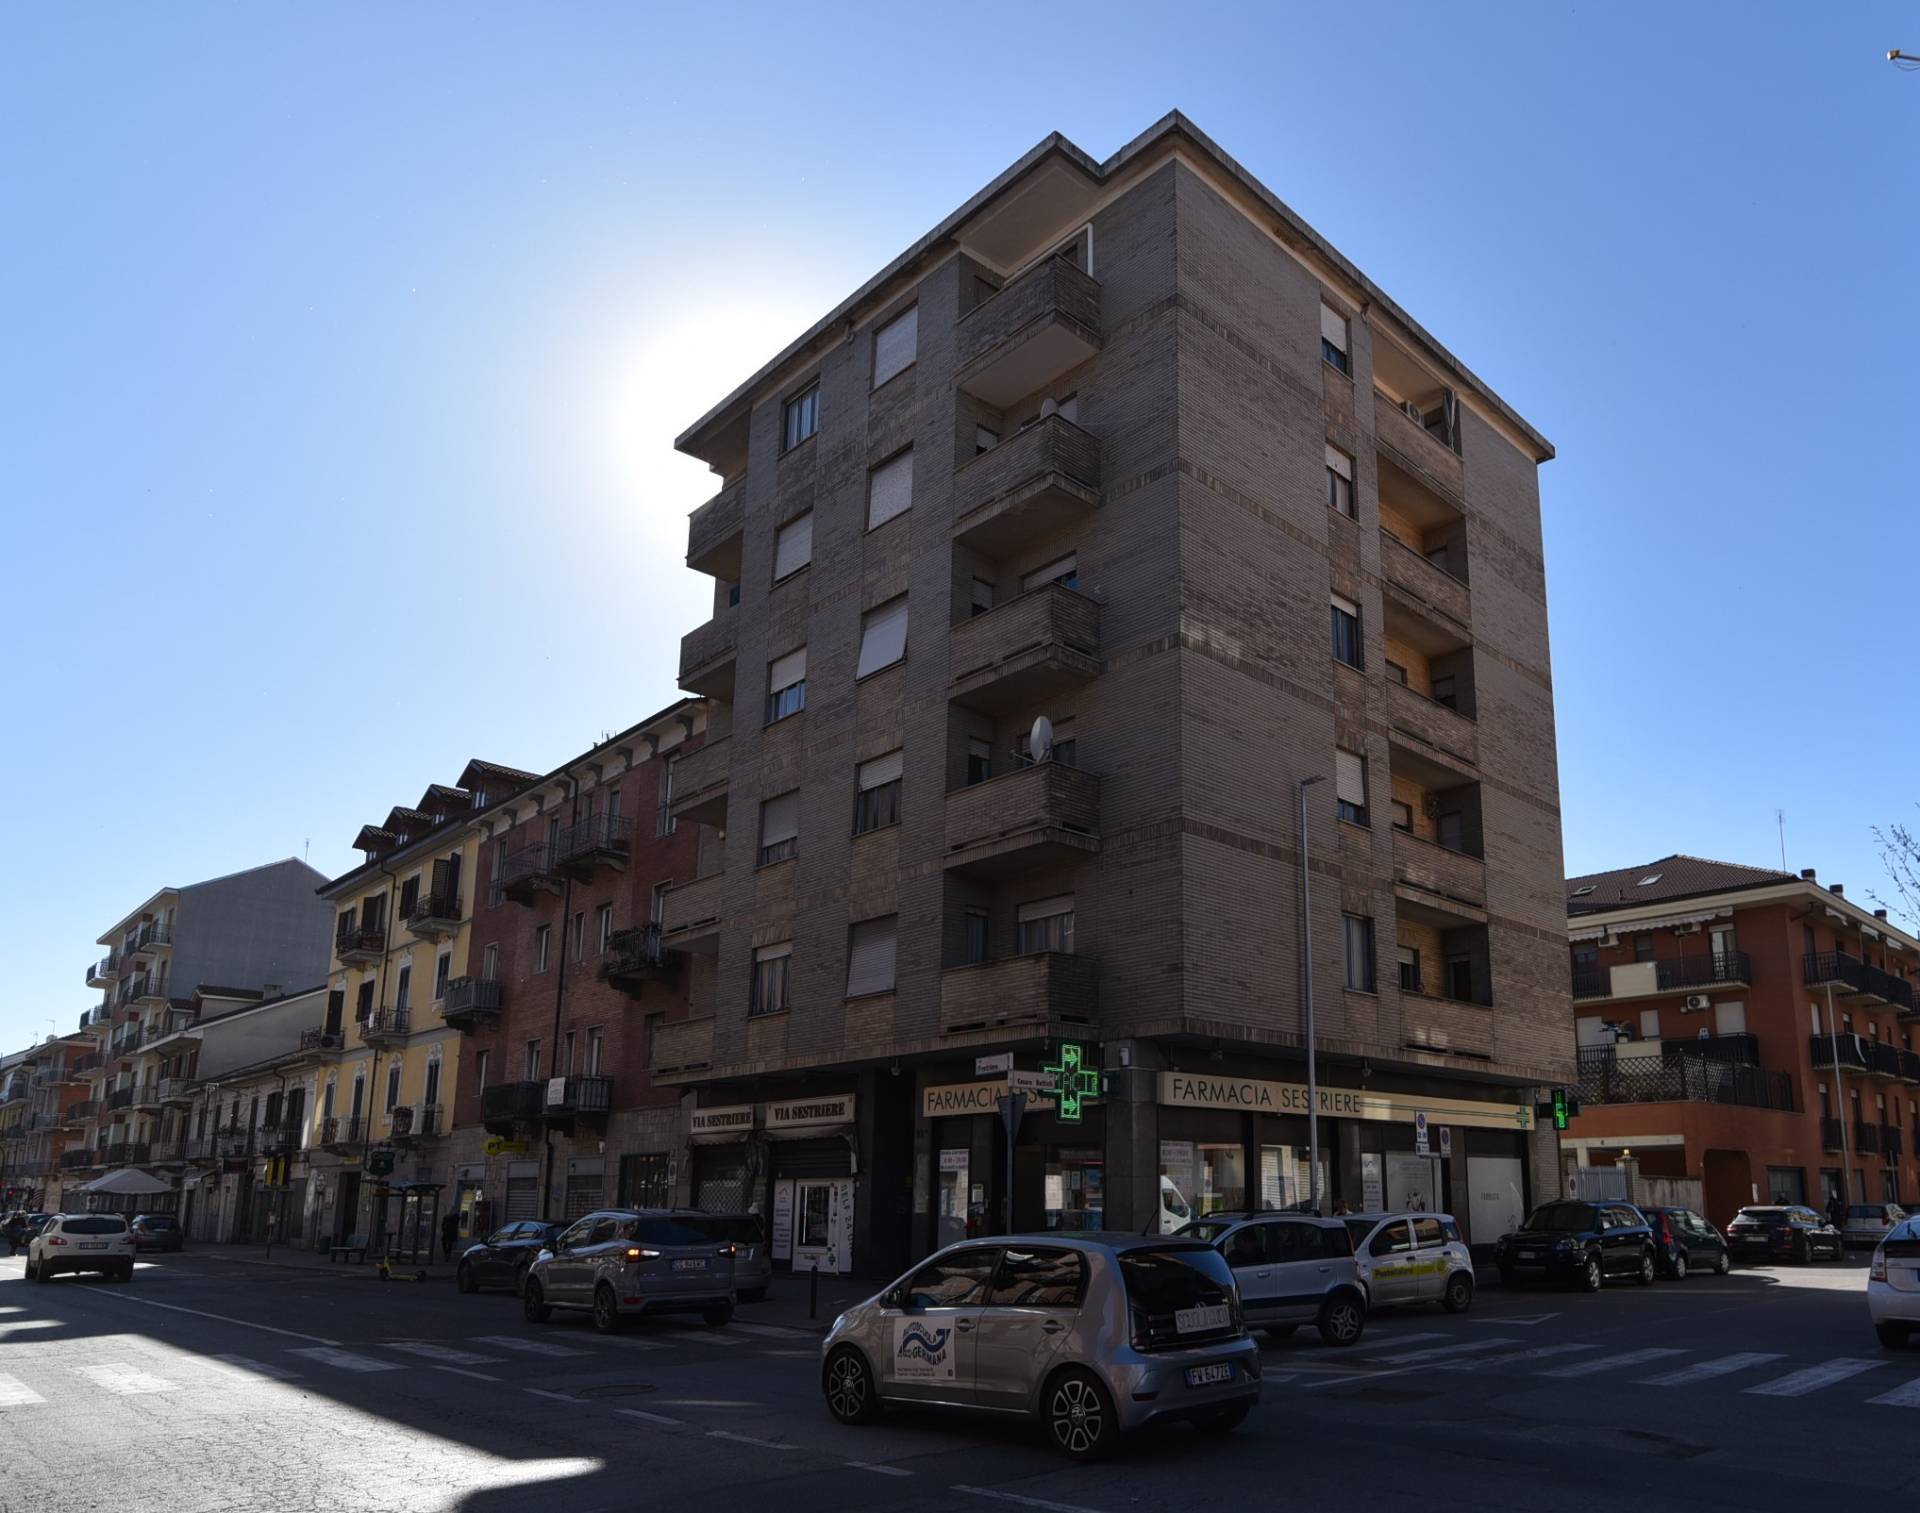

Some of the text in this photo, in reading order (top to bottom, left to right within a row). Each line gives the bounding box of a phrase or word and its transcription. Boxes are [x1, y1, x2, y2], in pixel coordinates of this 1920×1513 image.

[928, 1087, 1002, 1111] FARMACIA
[1173, 1078, 1272, 1106] FARMACIA
[692, 1111, 752, 1128] VIA SESTRIERE
[774, 1102, 845, 1121] VIA SESTRIERE
[841, 1184, 850, 1210] SELF
[903, 1321, 937, 1343] AUTOSCUOLA
[912, 1346, 946, 1366] GERMANA
